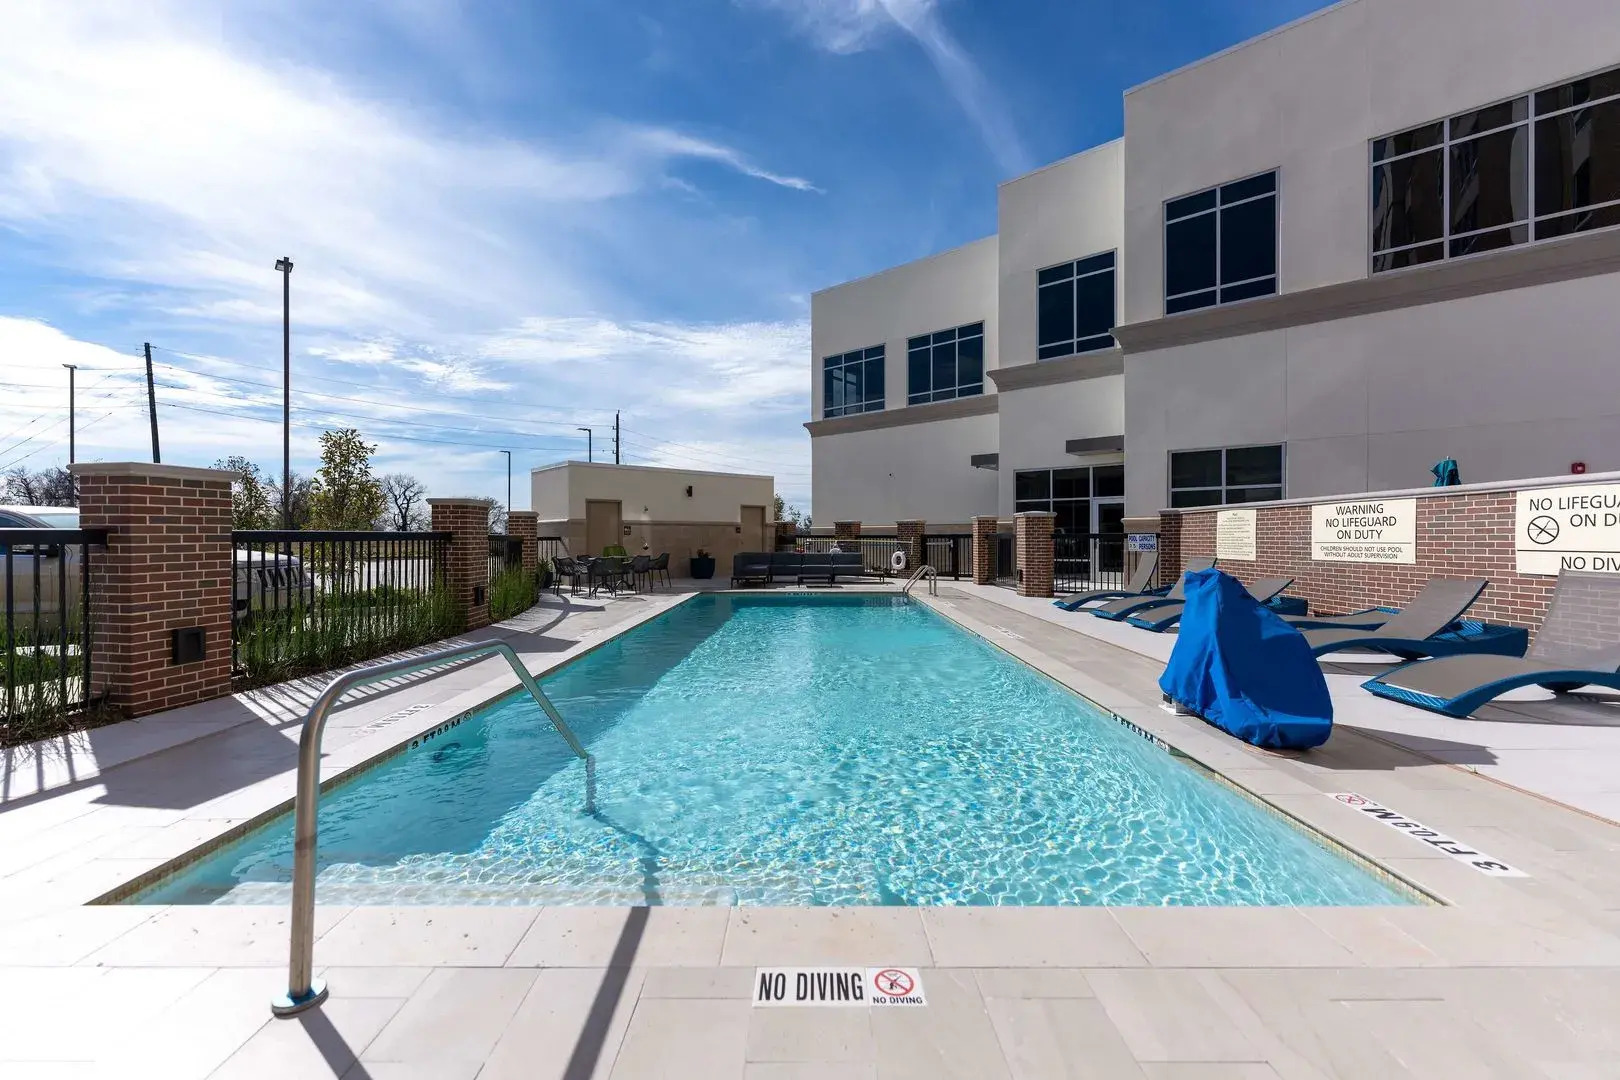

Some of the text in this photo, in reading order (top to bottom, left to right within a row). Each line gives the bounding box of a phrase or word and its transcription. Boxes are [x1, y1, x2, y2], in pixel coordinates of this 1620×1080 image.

[1336, 504, 1384, 516] WARNING
[1529, 498, 1552, 511] NO
[1326, 516, 1397, 528] NO LIFEGUARD
[1570, 514, 1620, 527] ON D
[1337, 529, 1383, 540] ON DUTY
[1561, 557, 1586, 570] NO
[1472, 861, 1509, 872] 3
[758, 972, 864, 1001] NO DIVING
